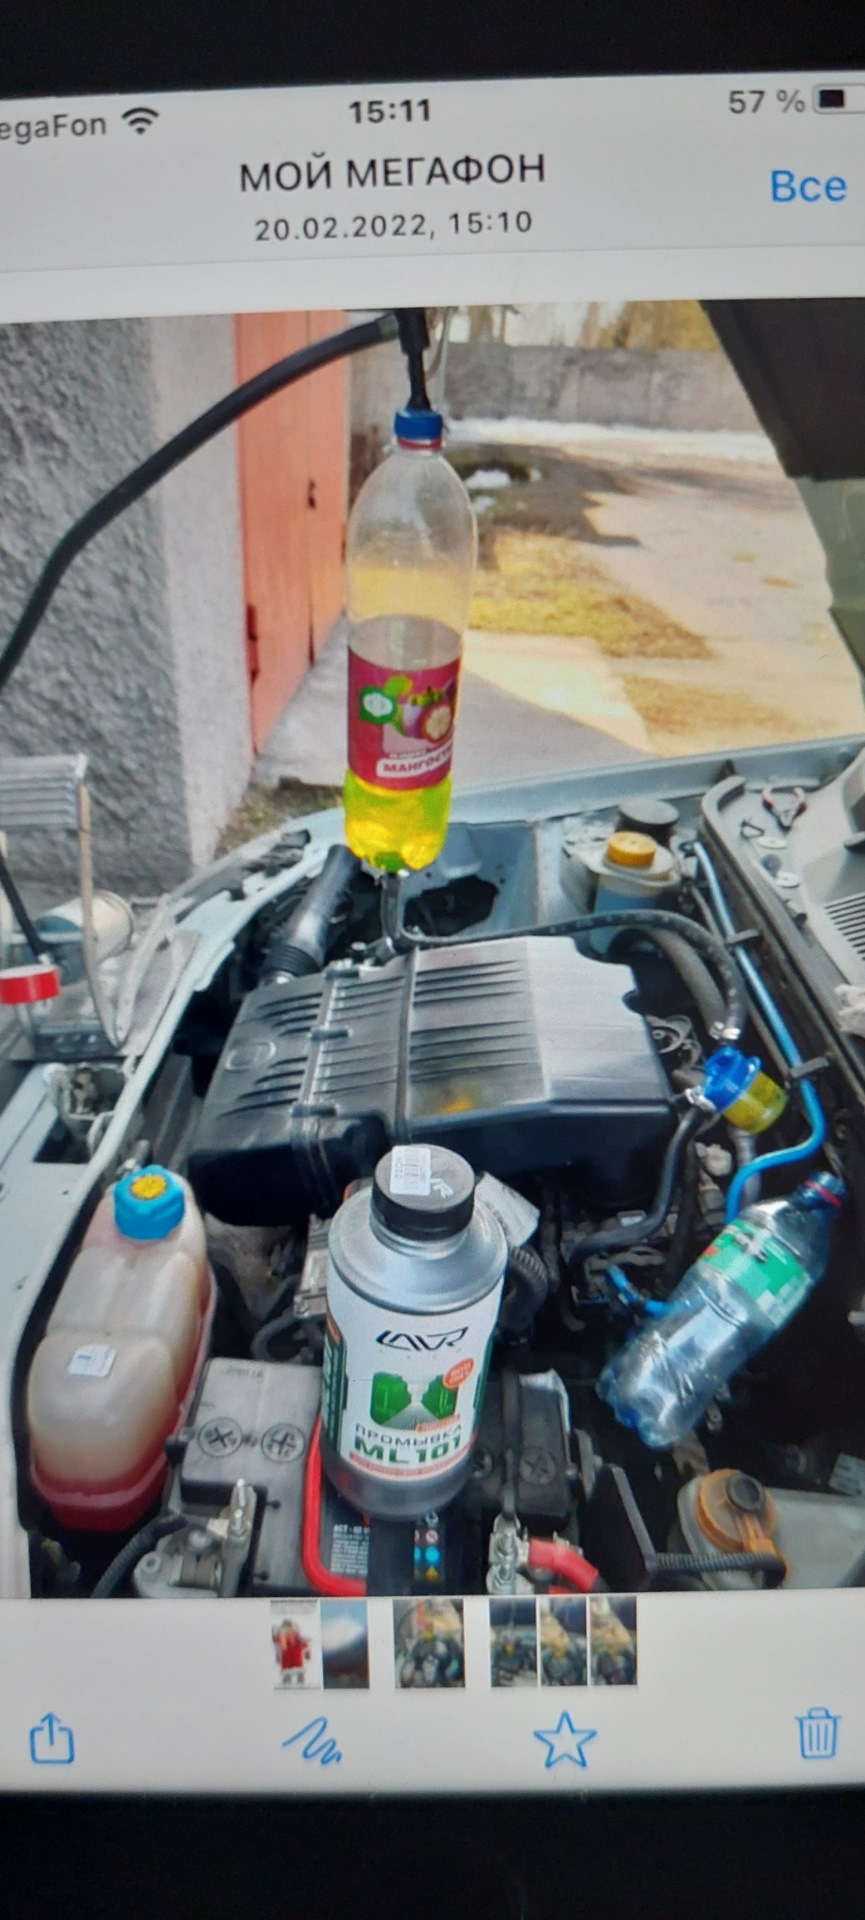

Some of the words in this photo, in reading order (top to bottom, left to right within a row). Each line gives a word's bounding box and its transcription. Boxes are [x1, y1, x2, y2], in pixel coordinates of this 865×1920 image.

[349, 98, 432, 124] 15:11
[729, 90, 766, 115] 57
[776, 88, 806, 113] %
[240, 151, 332, 193] МОЙ
[347, 153, 545, 189] МЕГАФОН
[770, 169, 848, 203] Все
[254, 212, 437, 242] 20.02.2022,
[448, 210, 533, 235] 15:10
[375, 1326, 469, 1352] LAVR
[355, 1422, 462, 1447] ПРОМЫВКА
